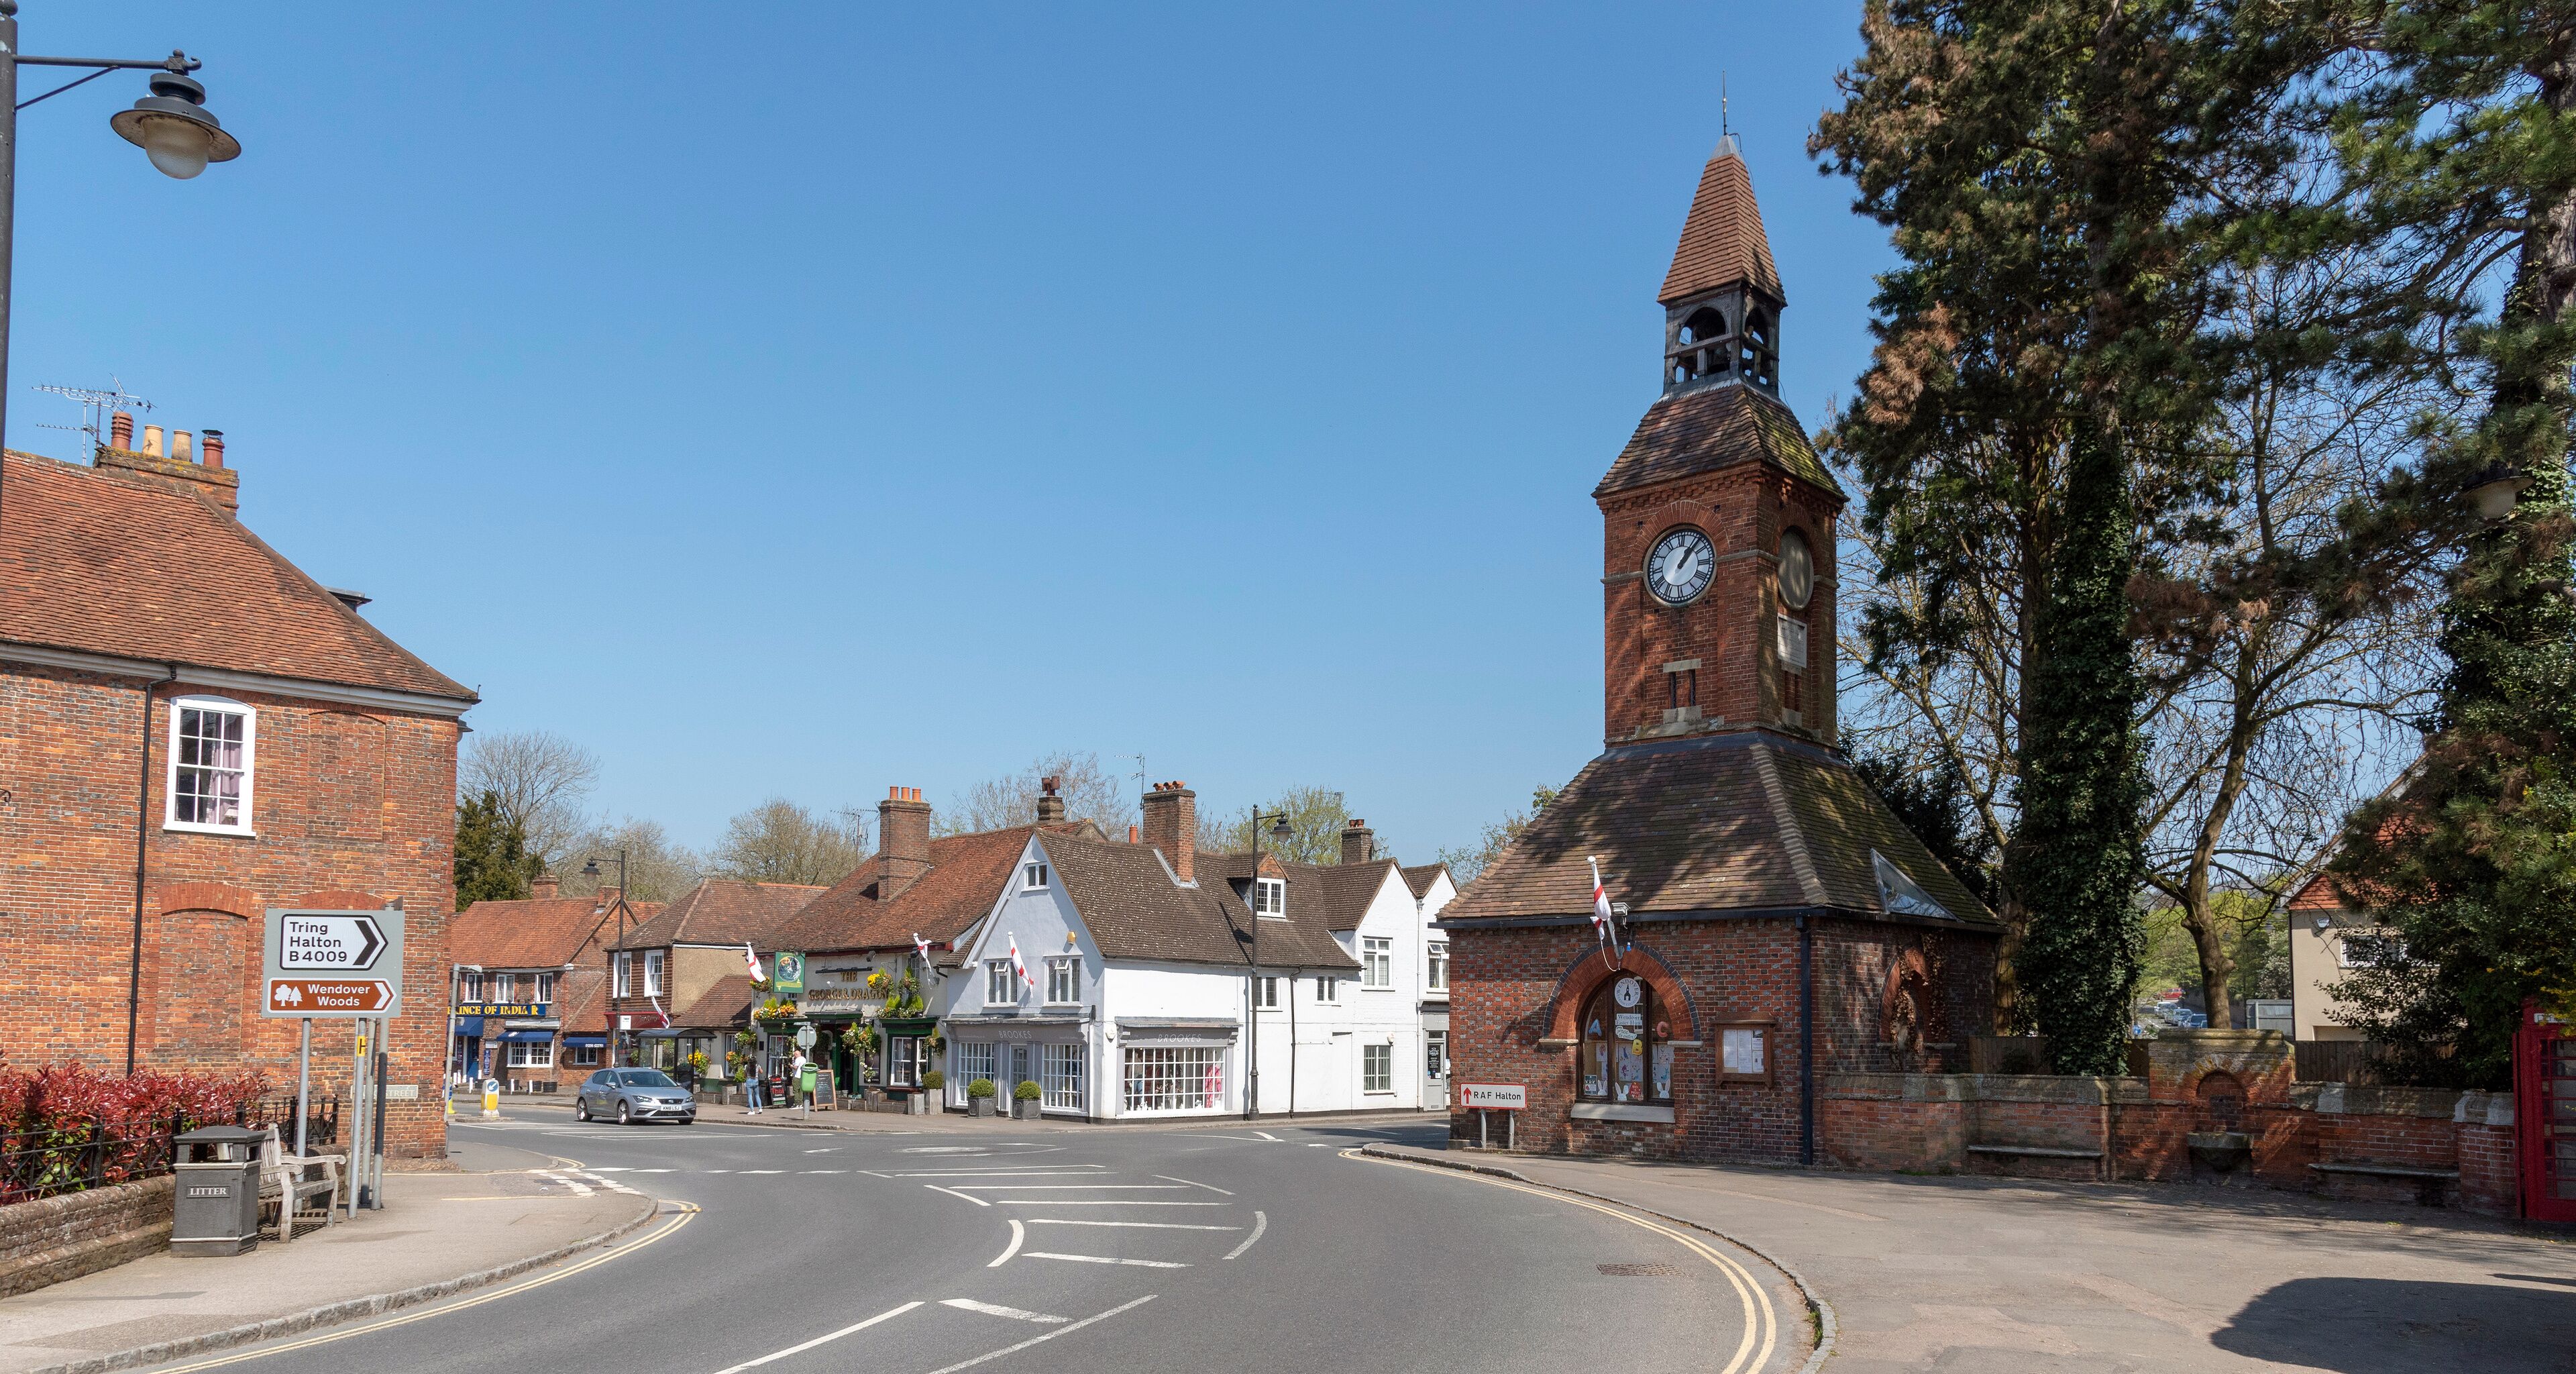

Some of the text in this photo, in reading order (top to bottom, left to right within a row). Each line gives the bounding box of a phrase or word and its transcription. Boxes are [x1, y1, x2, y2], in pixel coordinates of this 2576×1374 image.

[290, 922, 328, 935] Tring
[290, 937, 341, 947] Halton
[290, 951, 347, 961] B4009
[841, 971, 858, 982] THE
[308, 984, 370, 994] Wendover
[1617, 980, 1639, 996] WENDOVER
[808, 988, 843, 1000] GEORGE
[317, 996, 360, 1006] Woods
[447, 1006, 481, 1015] PINCE
[484, 1006, 497, 1015] OF
[500, 1006, 528, 1015] INDIA
[998, 1030, 1032, 1039] BROOKES
[1158, 1034, 1201, 1043] BROOKES
[1474, 1091, 1492, 1099] RAF
[190, 1187, 227, 1196] LITTER
